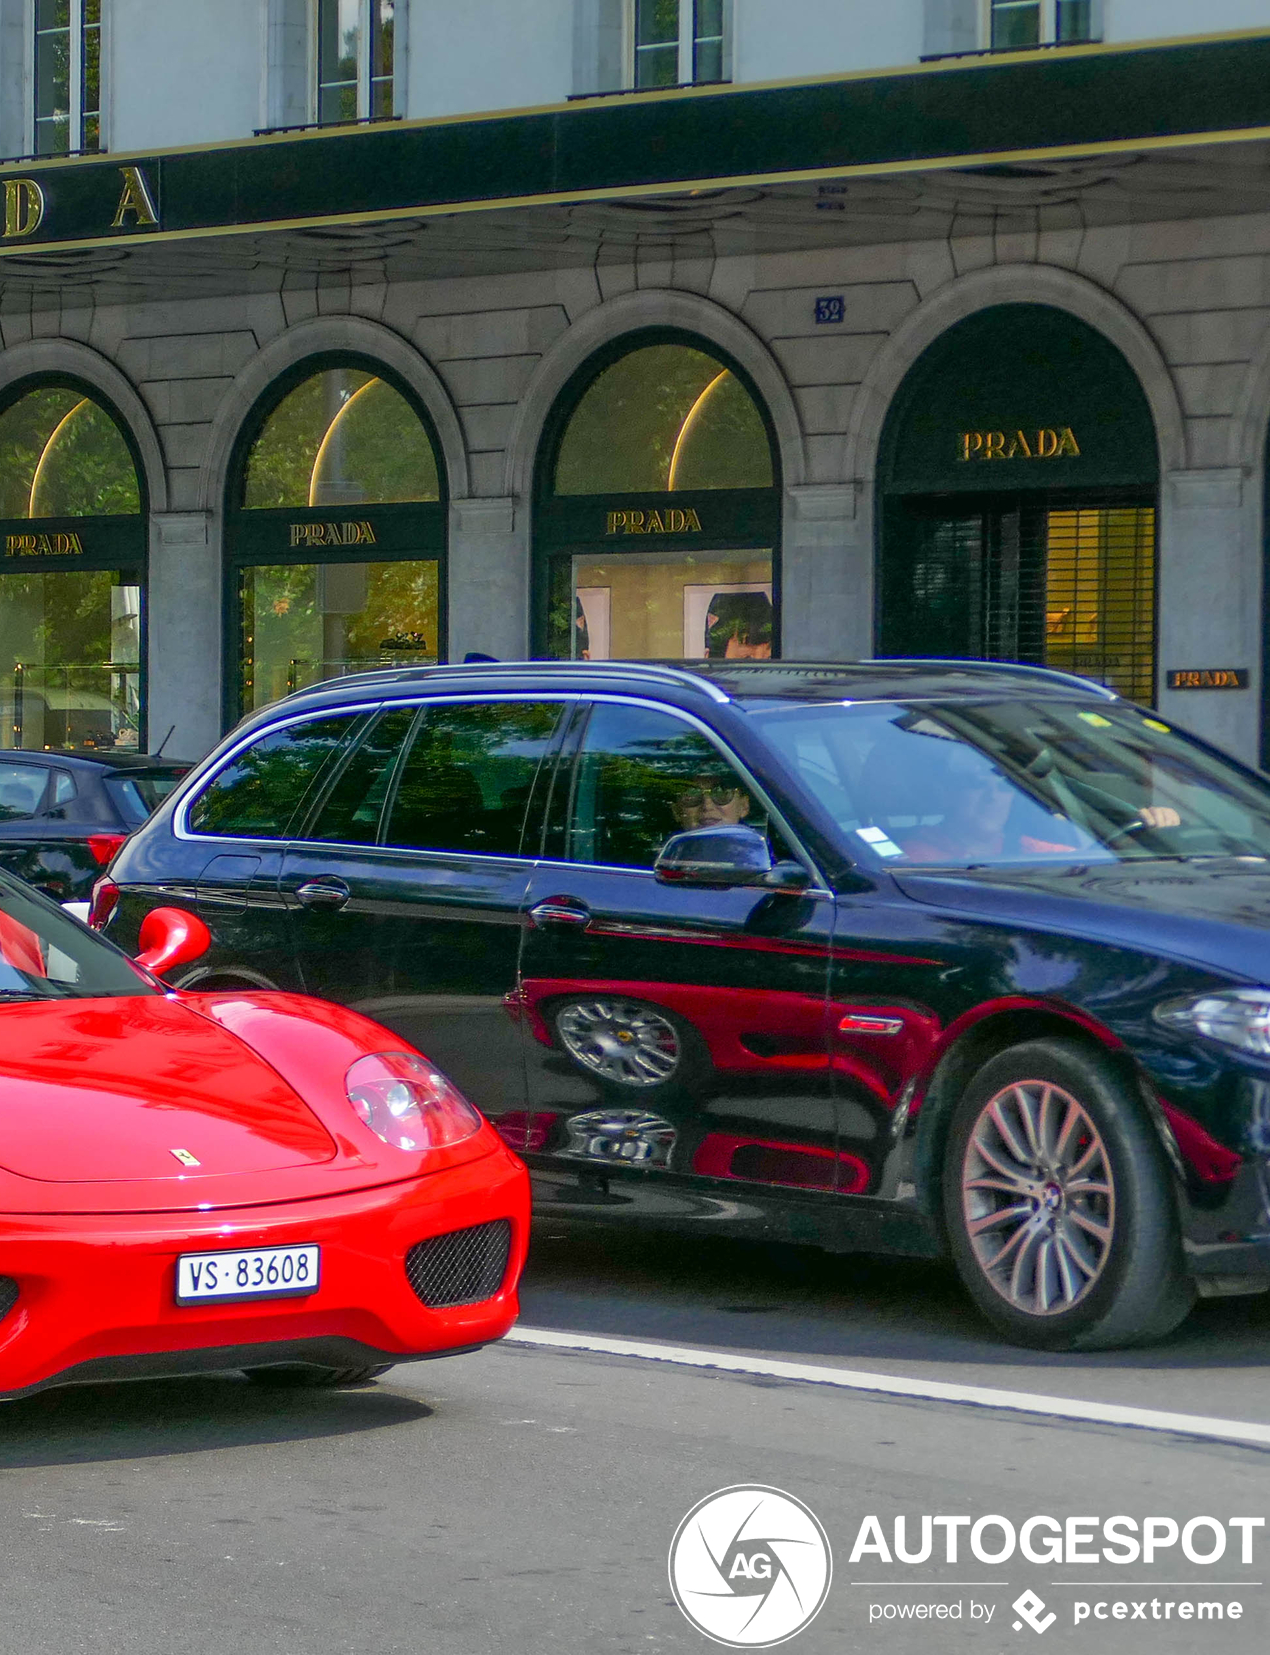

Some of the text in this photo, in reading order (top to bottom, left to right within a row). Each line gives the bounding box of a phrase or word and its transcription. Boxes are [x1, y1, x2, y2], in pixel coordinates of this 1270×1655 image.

[818, 300, 840, 320] 32
[956, 427, 1081, 461] PRADA
[289, 521, 377, 547] PRADA
[605, 508, 703, 535] PRADA
[5, 533, 84, 557] PRADA
[1173, 670, 1240, 687] PRADA
